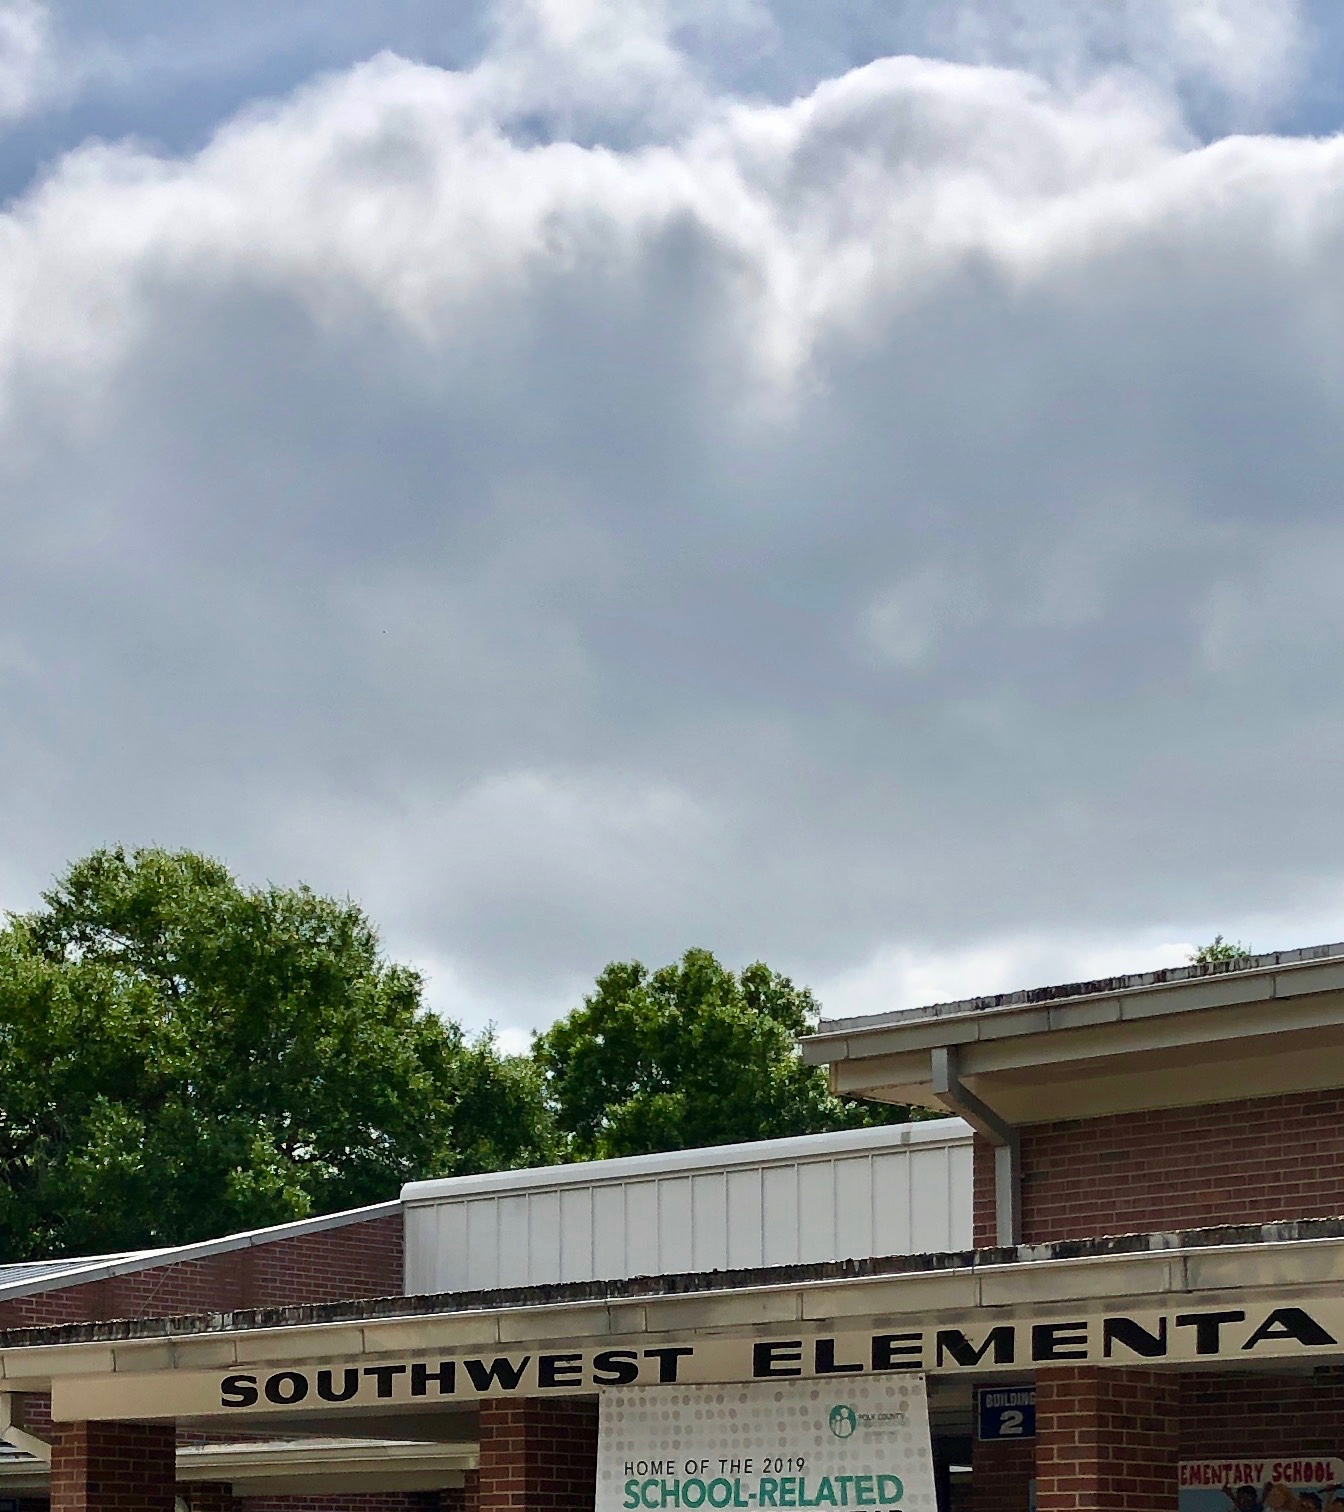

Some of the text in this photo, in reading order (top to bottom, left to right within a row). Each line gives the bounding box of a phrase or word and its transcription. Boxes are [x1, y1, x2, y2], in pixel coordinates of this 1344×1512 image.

[220, 1347, 694, 1408] SOUTHWEST
[999, 1410, 1023, 1435] 2
[624, 1457, 805, 1476] HOME OF THE 2019
[1272, 1461, 1334, 1482] SCHOOL
[623, 1474, 904, 1509] SCHOOL-RELATED
